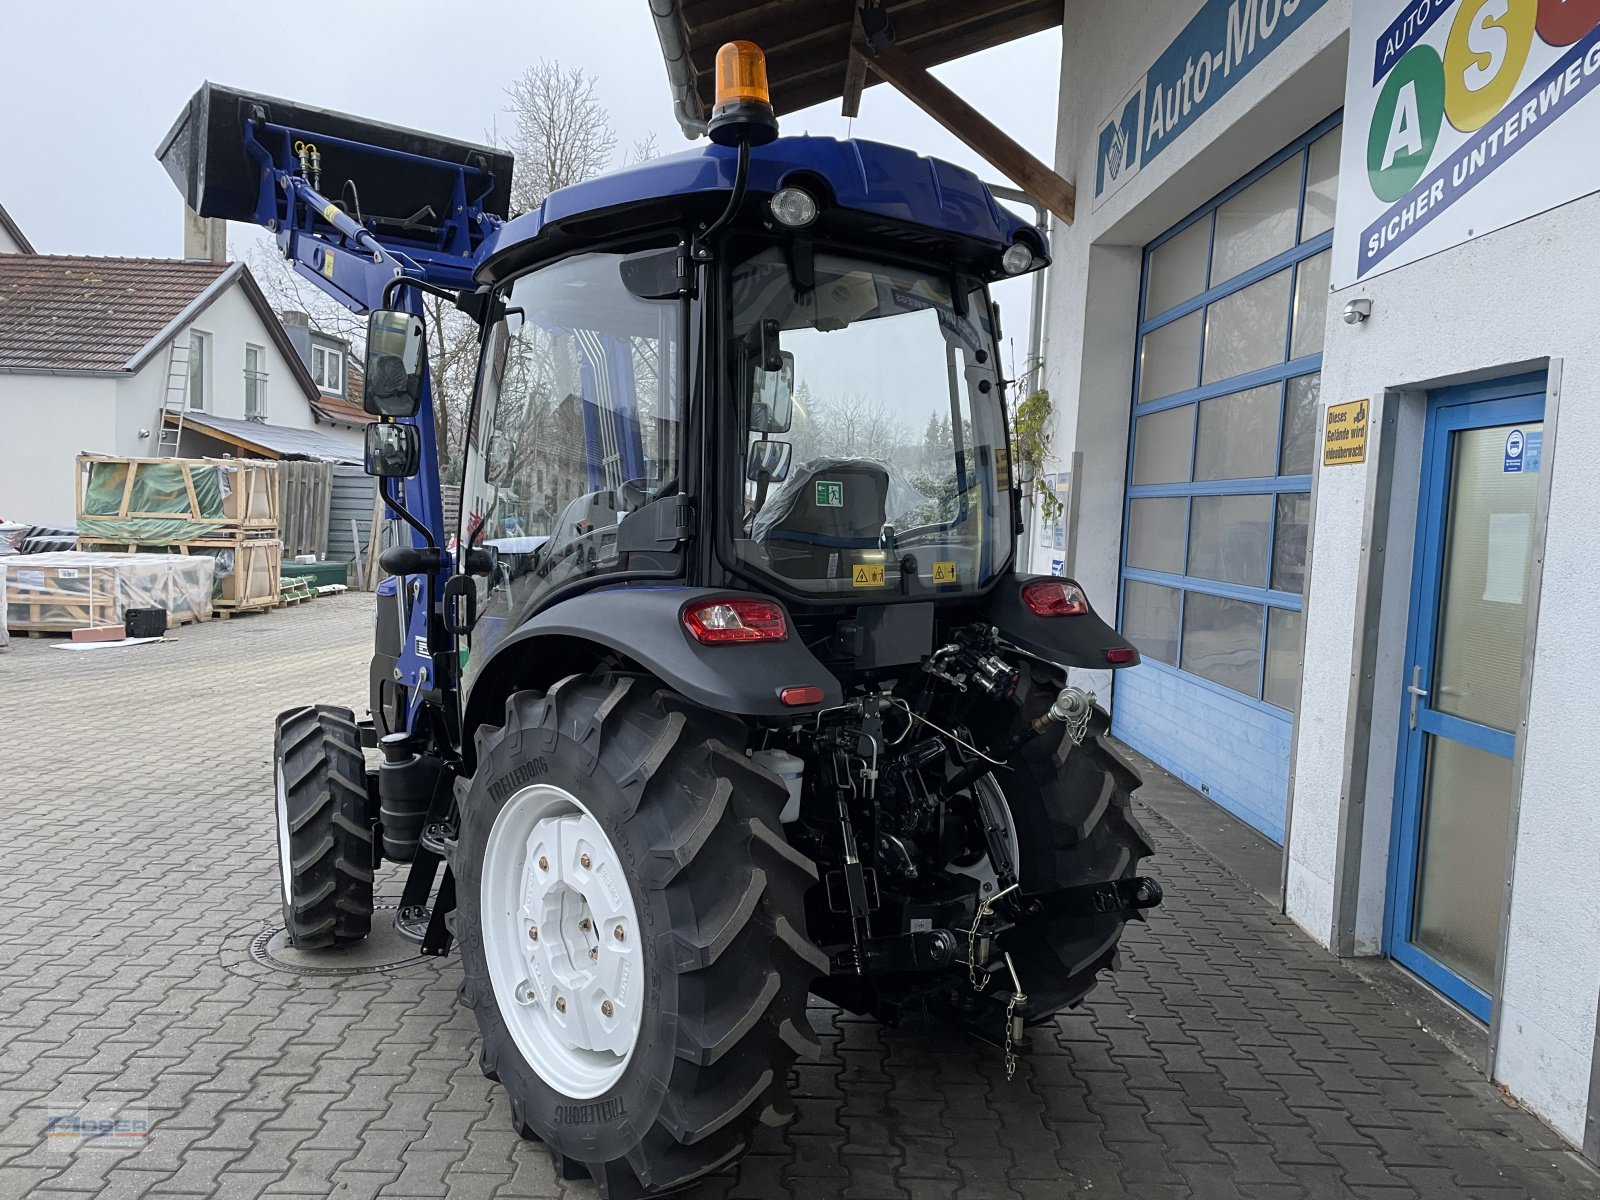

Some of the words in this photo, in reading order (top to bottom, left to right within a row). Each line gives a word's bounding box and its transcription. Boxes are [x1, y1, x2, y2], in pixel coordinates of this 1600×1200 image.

[1382, 0, 1431, 65] AUTO
[1367, 178, 1444, 258] SICHER
[1327, 428, 1349, 442] Gelände
[1350, 425, 1365, 438] wird
[1328, 412, 1347, 424] Dieses
[486, 755, 548, 803] TRELLEBORG
[554, 1095, 628, 1126] TRELLEBORG
